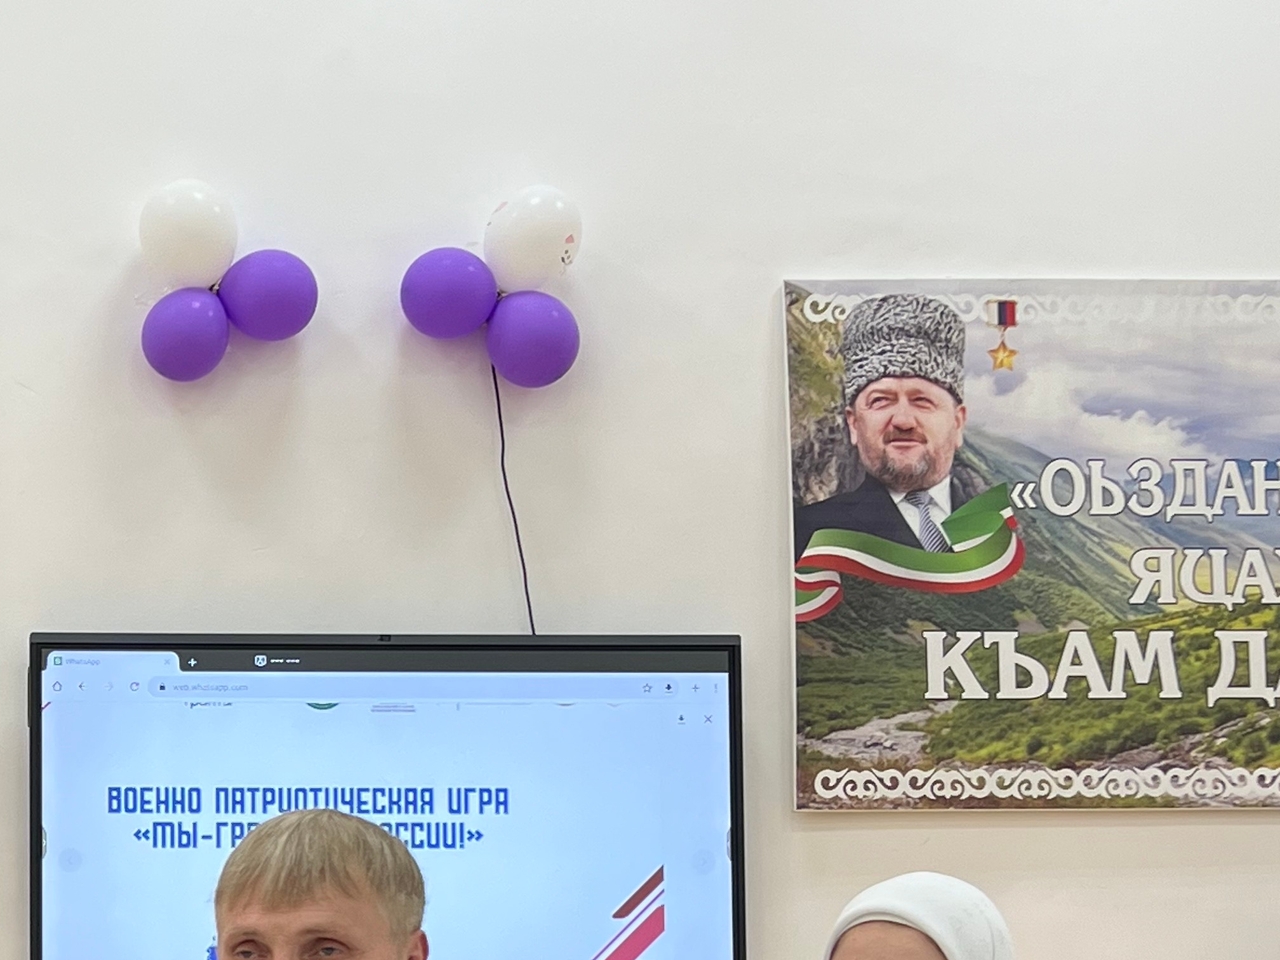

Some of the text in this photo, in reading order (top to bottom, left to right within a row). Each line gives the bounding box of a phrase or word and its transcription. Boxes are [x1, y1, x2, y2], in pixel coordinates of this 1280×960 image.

[1128, 547, 1280, 612] ЯЦА
[922, 630, 1280, 708] КЪАМ Д
[107, 786, 509, 815] ВОЕННО ПАТРИОТИЧЕСКАЯ ИГРА
[133, 821, 261, 849] «ТЫ-ГР
